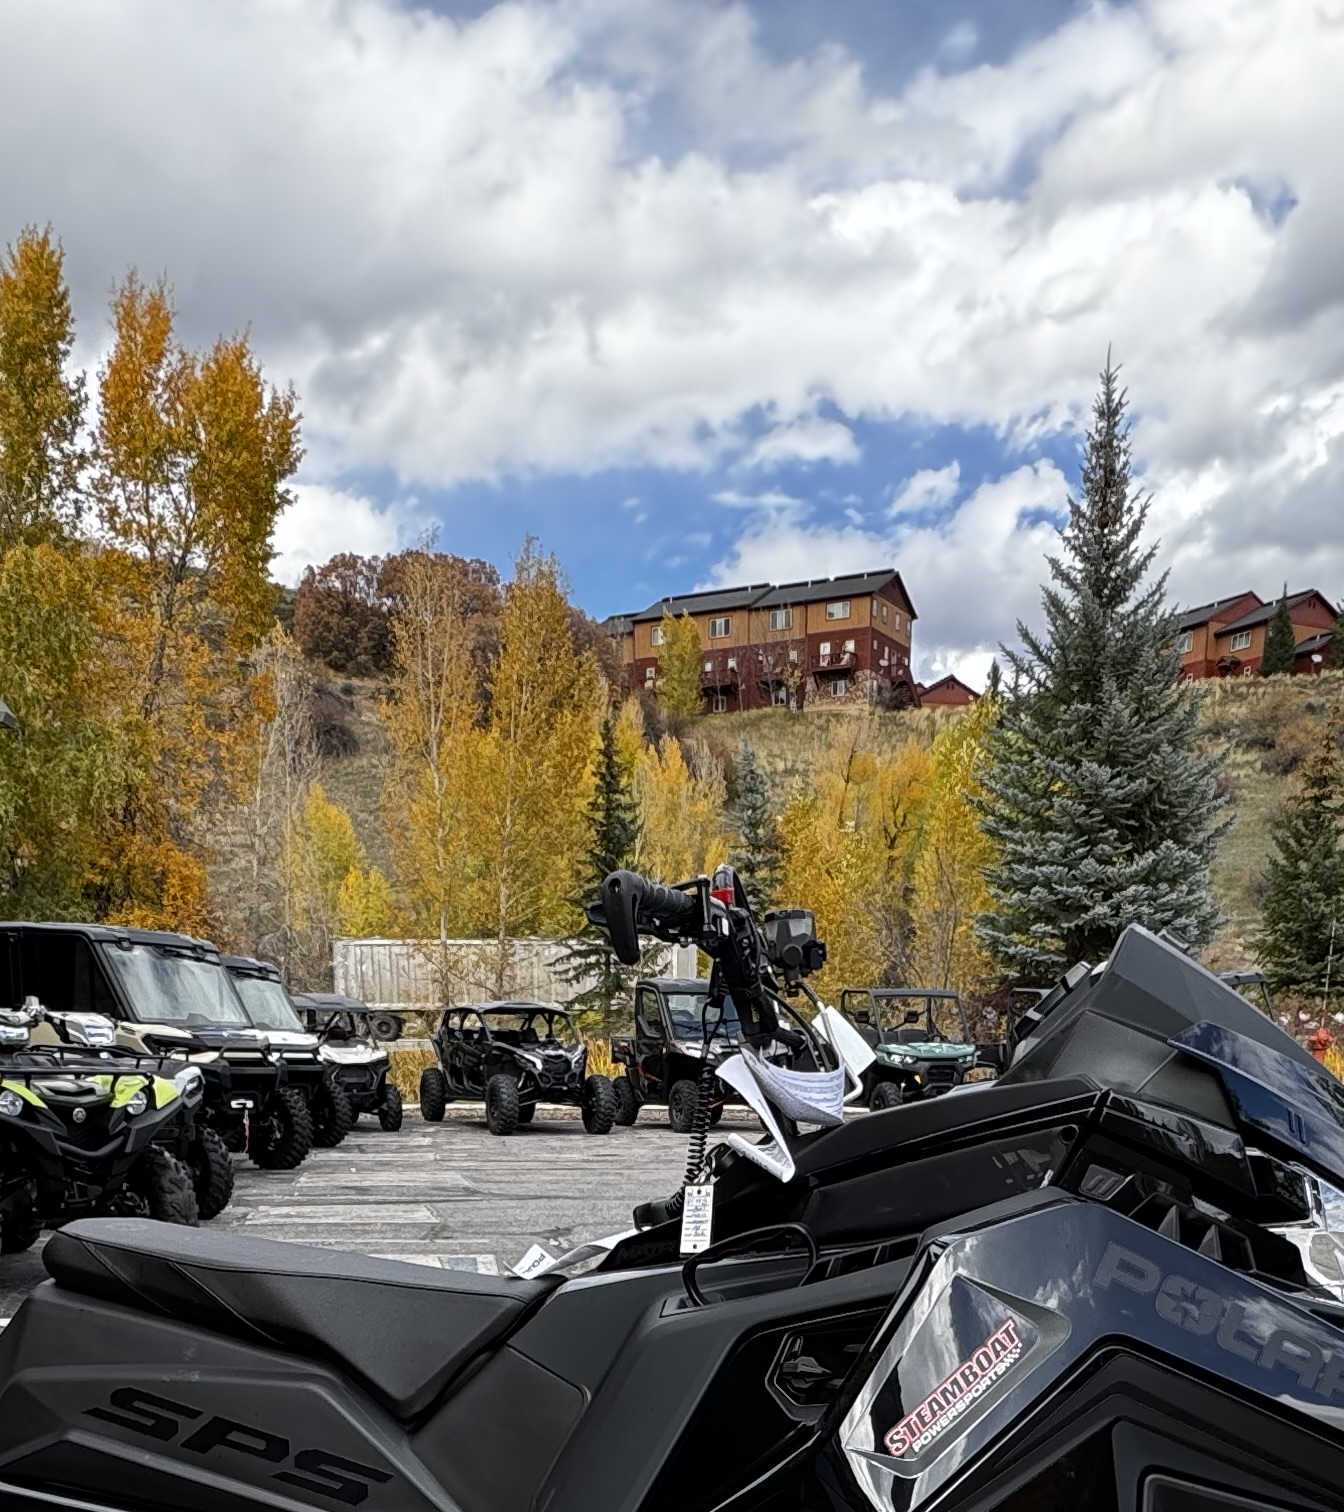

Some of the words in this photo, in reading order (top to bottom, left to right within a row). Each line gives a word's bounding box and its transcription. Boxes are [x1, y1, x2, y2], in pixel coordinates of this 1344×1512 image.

[81, 1386, 394, 1506] SPS
[884, 1317, 1021, 1457] STEAMBOAT
[911, 1361, 1007, 1454] POWERSPORTS
